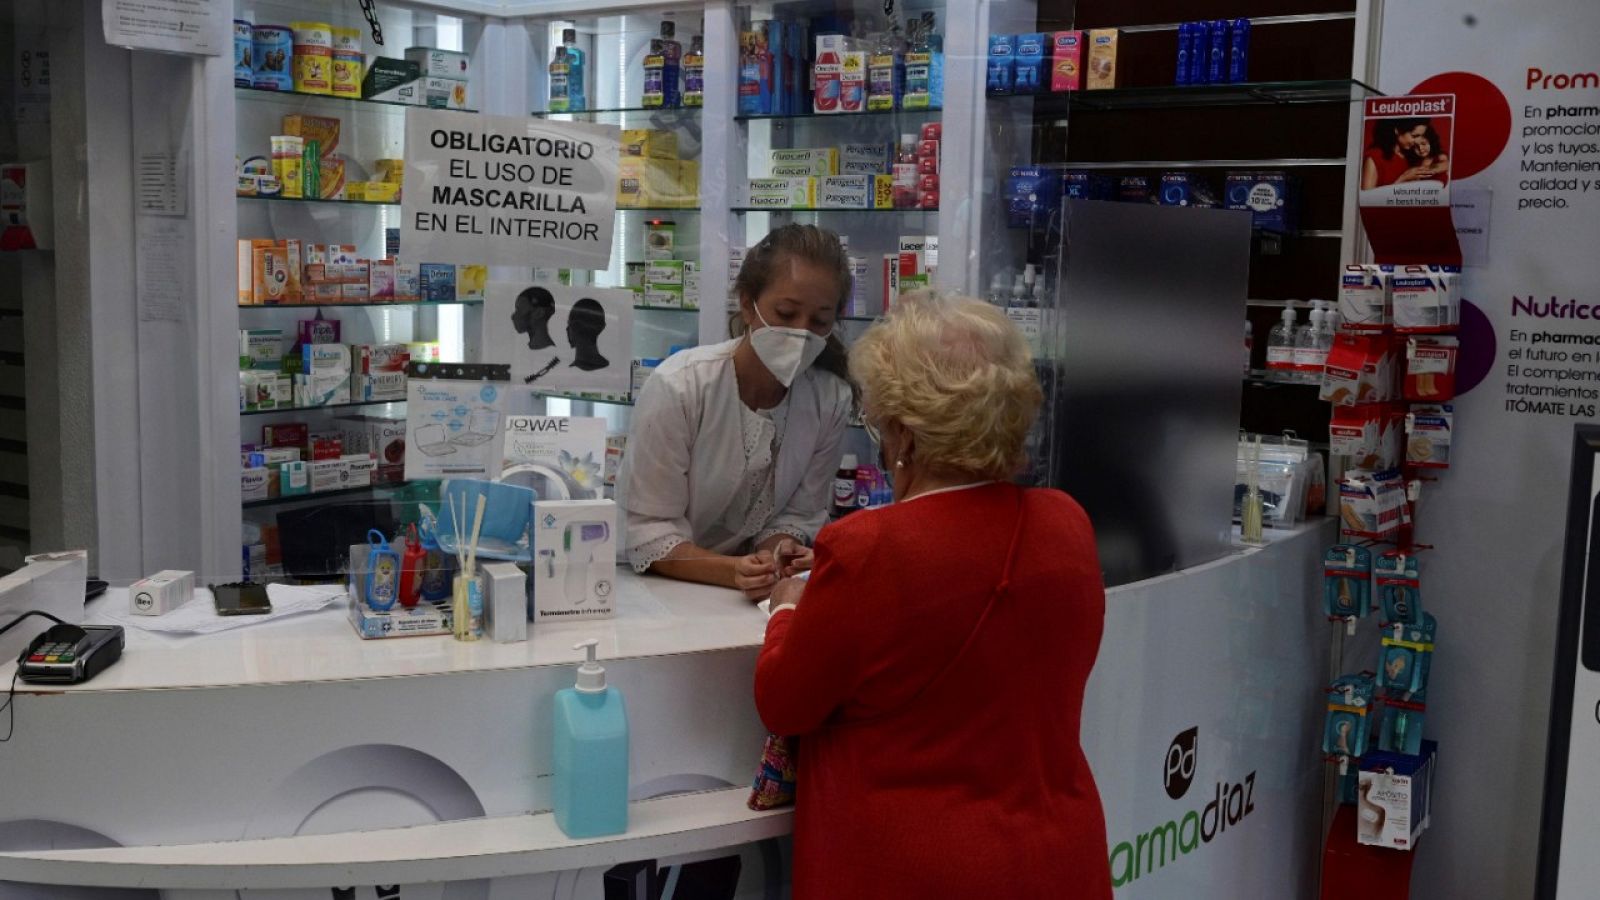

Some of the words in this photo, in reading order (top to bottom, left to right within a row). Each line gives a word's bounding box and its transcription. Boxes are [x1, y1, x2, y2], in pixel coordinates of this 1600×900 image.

[1526, 68, 1600, 90] Prom
[1371, 99, 1447, 116] Leukoplast
[1525, 105, 1542, 118] En
[1546, 105, 1600, 120] pharm
[430, 129, 594, 160] OBLIGATORIO
[1522, 144, 1531, 157] y
[1534, 142, 1554, 155] los
[450, 159, 478, 180] EL
[484, 162, 536, 184] USO
[542, 166, 573, 186] DE
[1393, 188, 1421, 196] Wound
[1519, 178, 1578, 191] calidad
[1581, 180, 1591, 193] y
[431, 185, 586, 214] MASCARILLA
[1387, 197, 1395, 206] in
[1396, 197, 1414, 206] best
[1415, 197, 1439, 206] hands
[1518, 196, 1569, 211] precio.
[415, 212, 447, 232] EN
[455, 215, 483, 235] EL
[490, 217, 599, 242] INTERIOR
[1510, 330, 1527, 342] En
[1508, 347, 1522, 360] el
[1526, 347, 1568, 361] futuro
[1571, 353, 1591, 363] en
[1508, 364, 1519, 376] El
[1506, 382, 1599, 400] tratamientos
[1569, 403, 1596, 417] LAS
